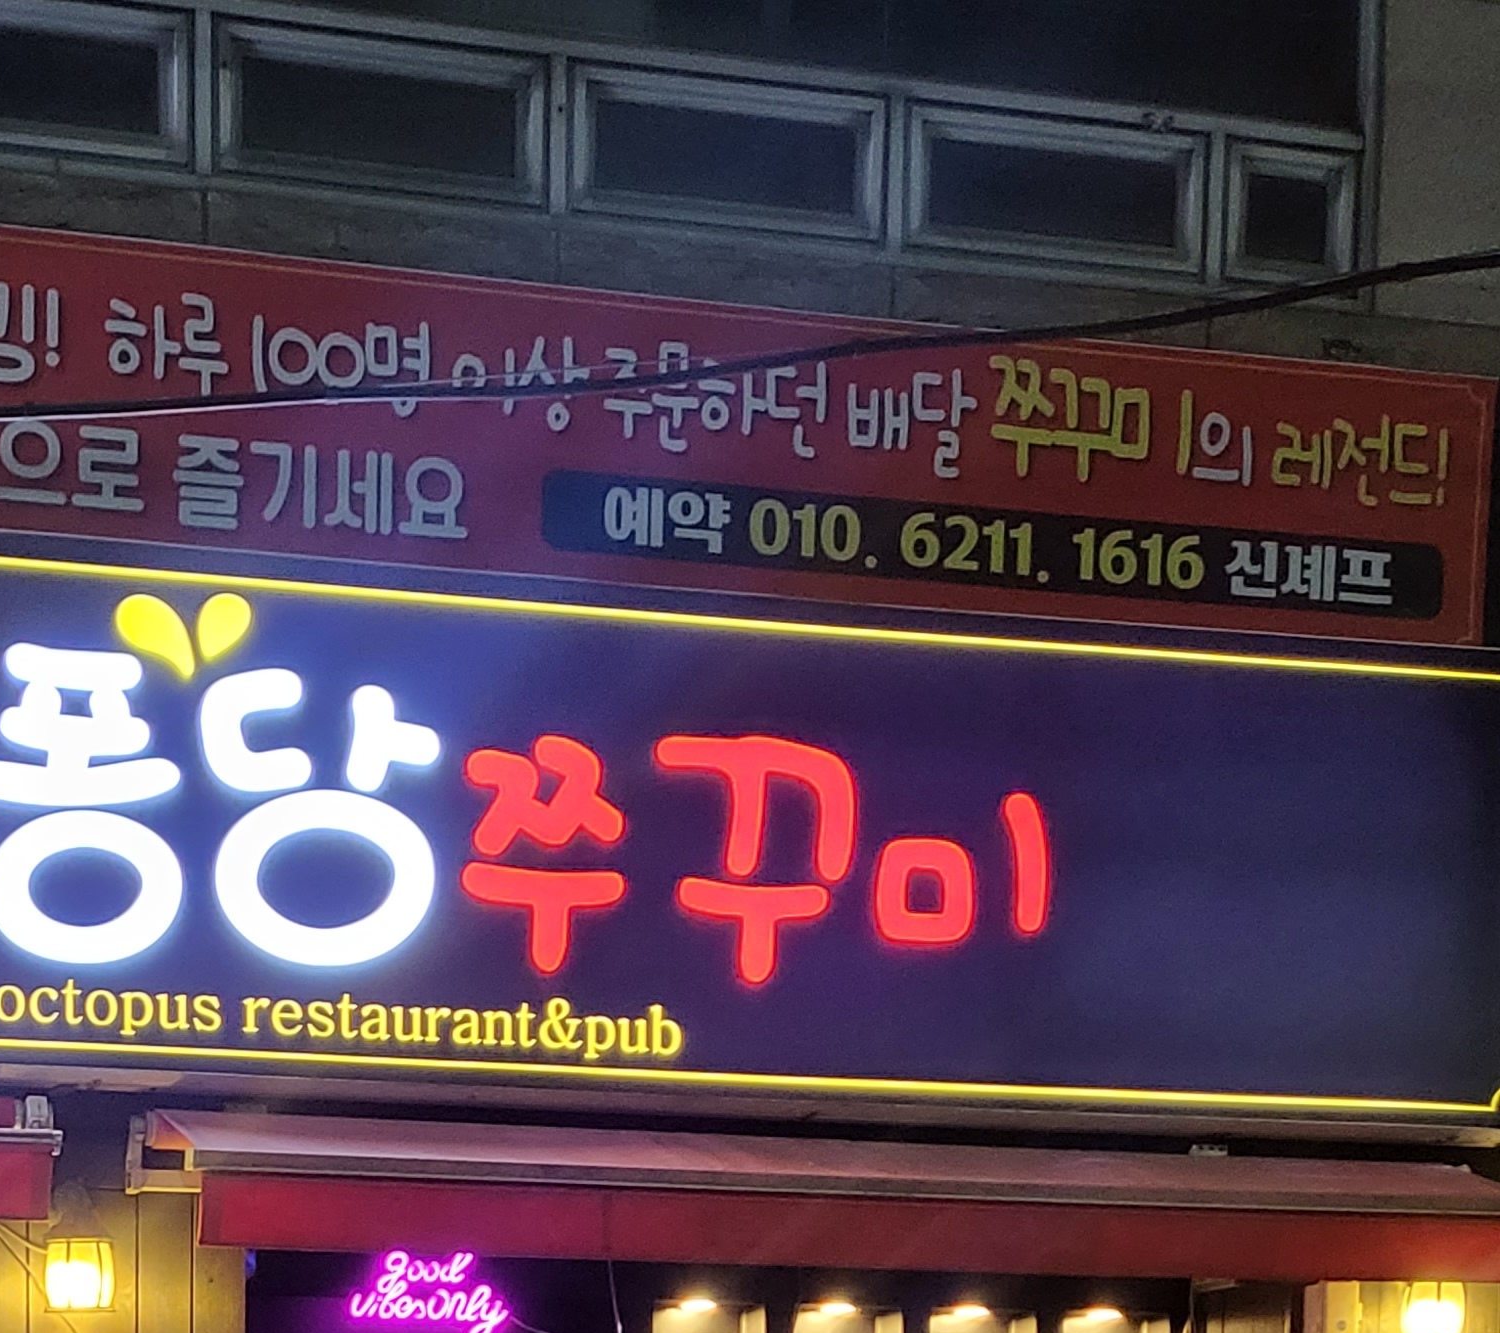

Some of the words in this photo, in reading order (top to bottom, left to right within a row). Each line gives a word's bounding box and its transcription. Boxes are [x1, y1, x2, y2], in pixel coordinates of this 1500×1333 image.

[105, 293, 230, 396] 하루
[451, 335, 591, 432] 이상
[603, 341, 828, 458] 주문하던
[847, 368, 978, 478] 배달
[1271, 414, 1449, 507] 레전드!
[173, 431, 469, 541] 즐기세요
[603, 485, 733, 557] 예약
[1072, 529, 1206, 590] 1616
[1223, 538, 1394, 606] 신셰프
[460, 732, 1052, 986] 쭈꾸미
[240, 990, 685, 1062] restaurant&pub
[376, 1249, 475, 1295] good
